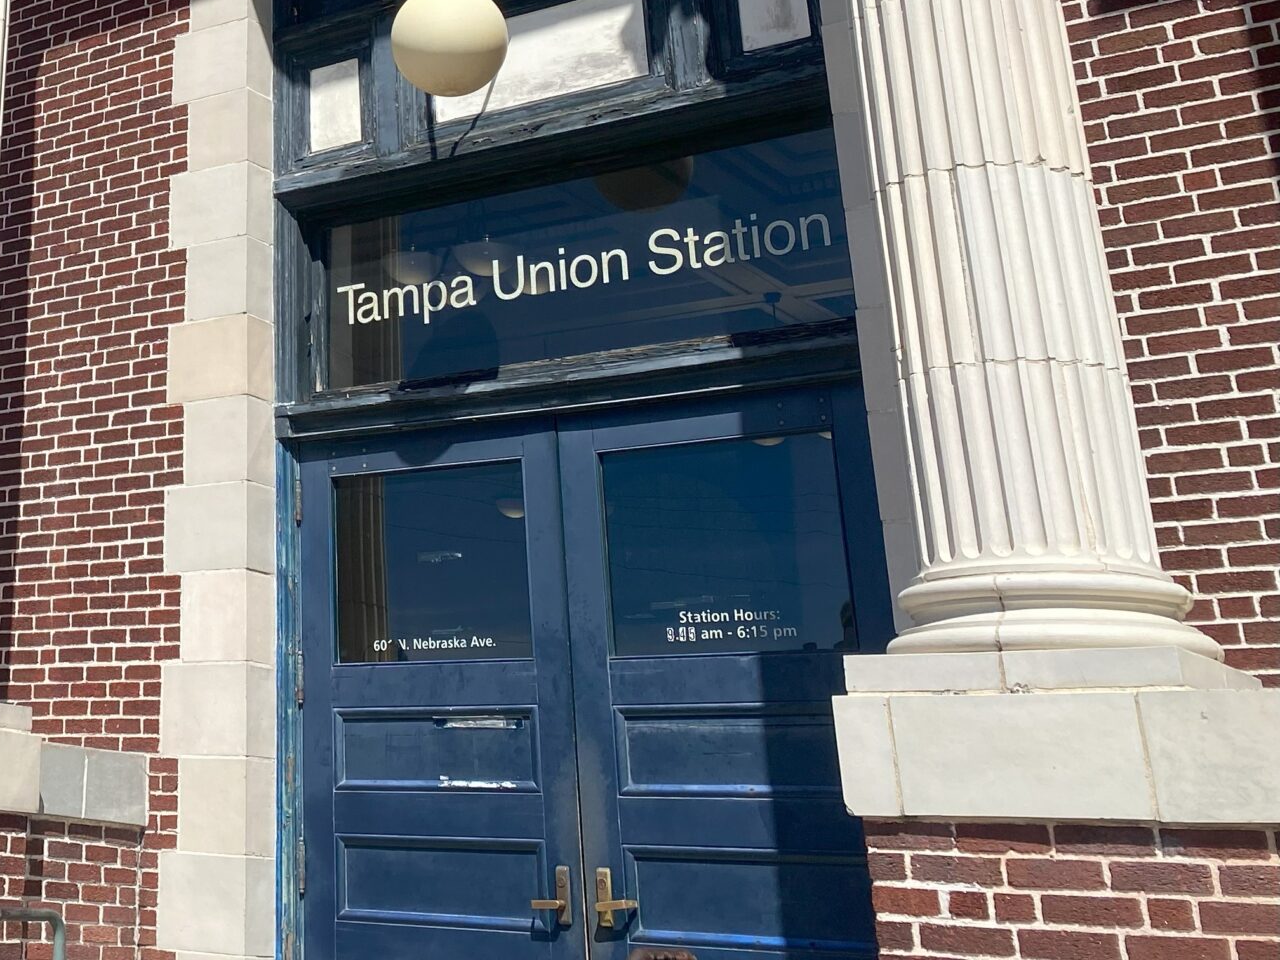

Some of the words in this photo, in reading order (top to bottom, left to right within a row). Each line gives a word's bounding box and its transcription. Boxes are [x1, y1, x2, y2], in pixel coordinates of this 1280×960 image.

[336, 275, 477, 326] Tampa
[491, 247, 629, 302] Union
[647, 212, 832, 276] Station
[679, 609, 730, 624] Station
[733, 608, 781, 622] Hours:
[701, 629, 723, 639] am
[736, 625, 768, 639] 6:15
[773, 625, 798, 640] pm
[413, 635, 468, 651] Nebraska
[470, 634, 497, 648] Ave.
